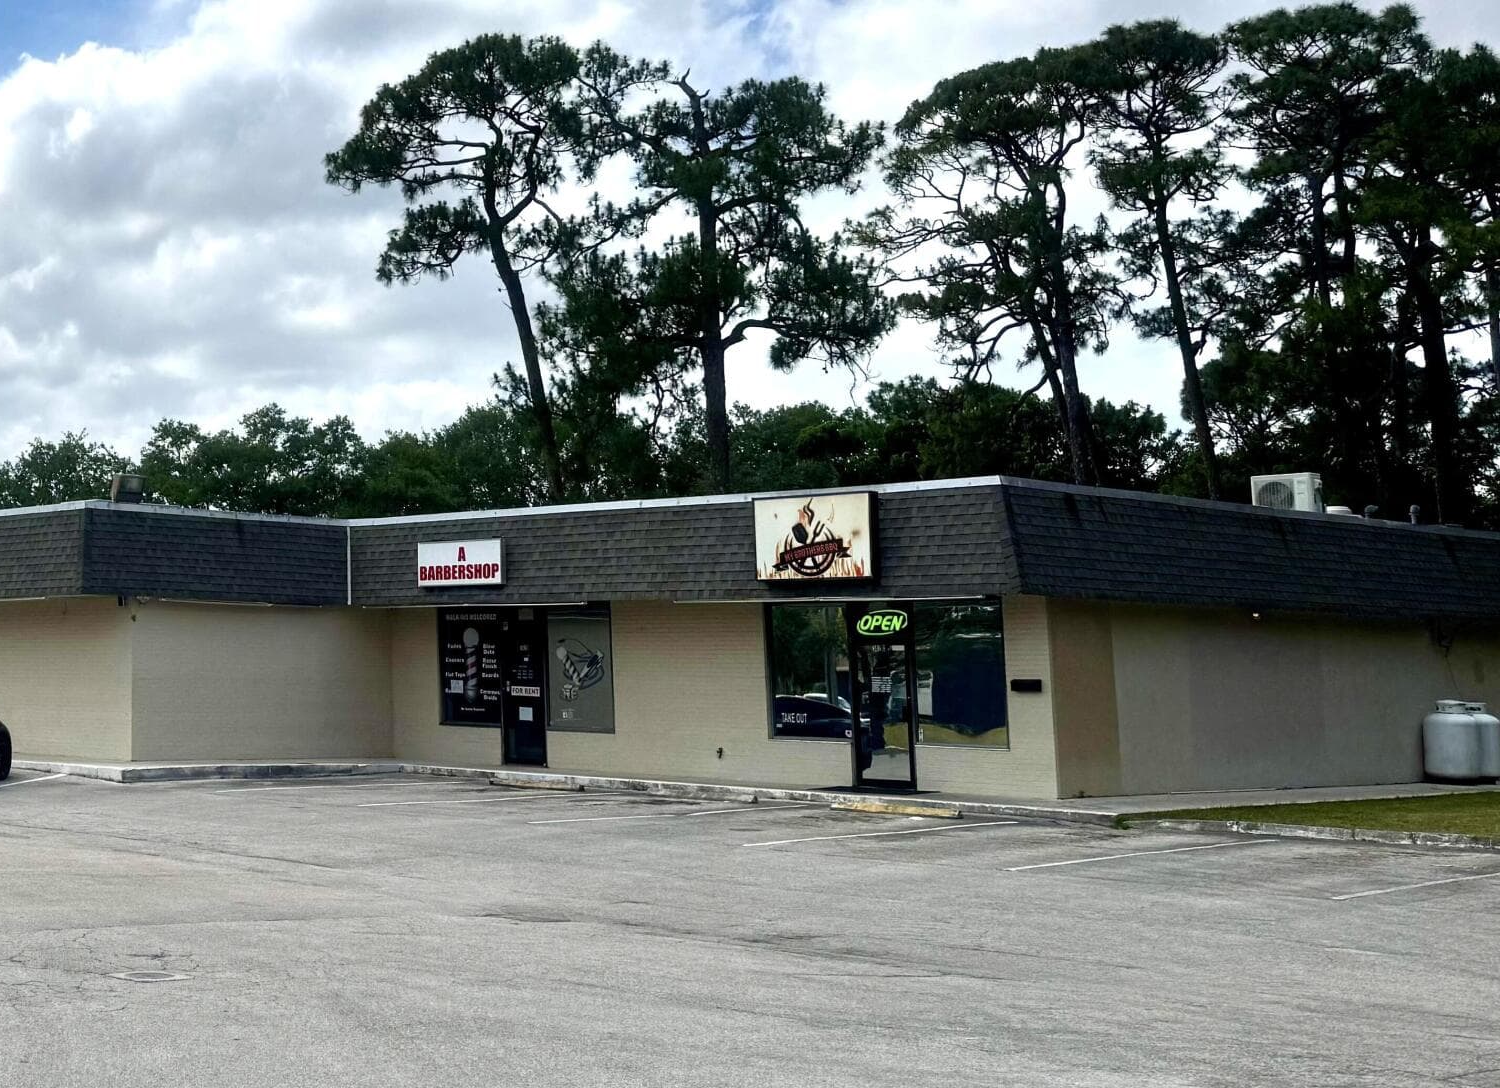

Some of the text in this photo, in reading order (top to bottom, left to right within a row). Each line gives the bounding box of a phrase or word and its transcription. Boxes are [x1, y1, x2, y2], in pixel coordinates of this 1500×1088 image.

[458, 547, 466, 561] A
[420, 563, 499, 581] BARBERSHOP
[860, 615, 903, 631] OPEN
[781, 712, 808, 724] TAKE OUT
